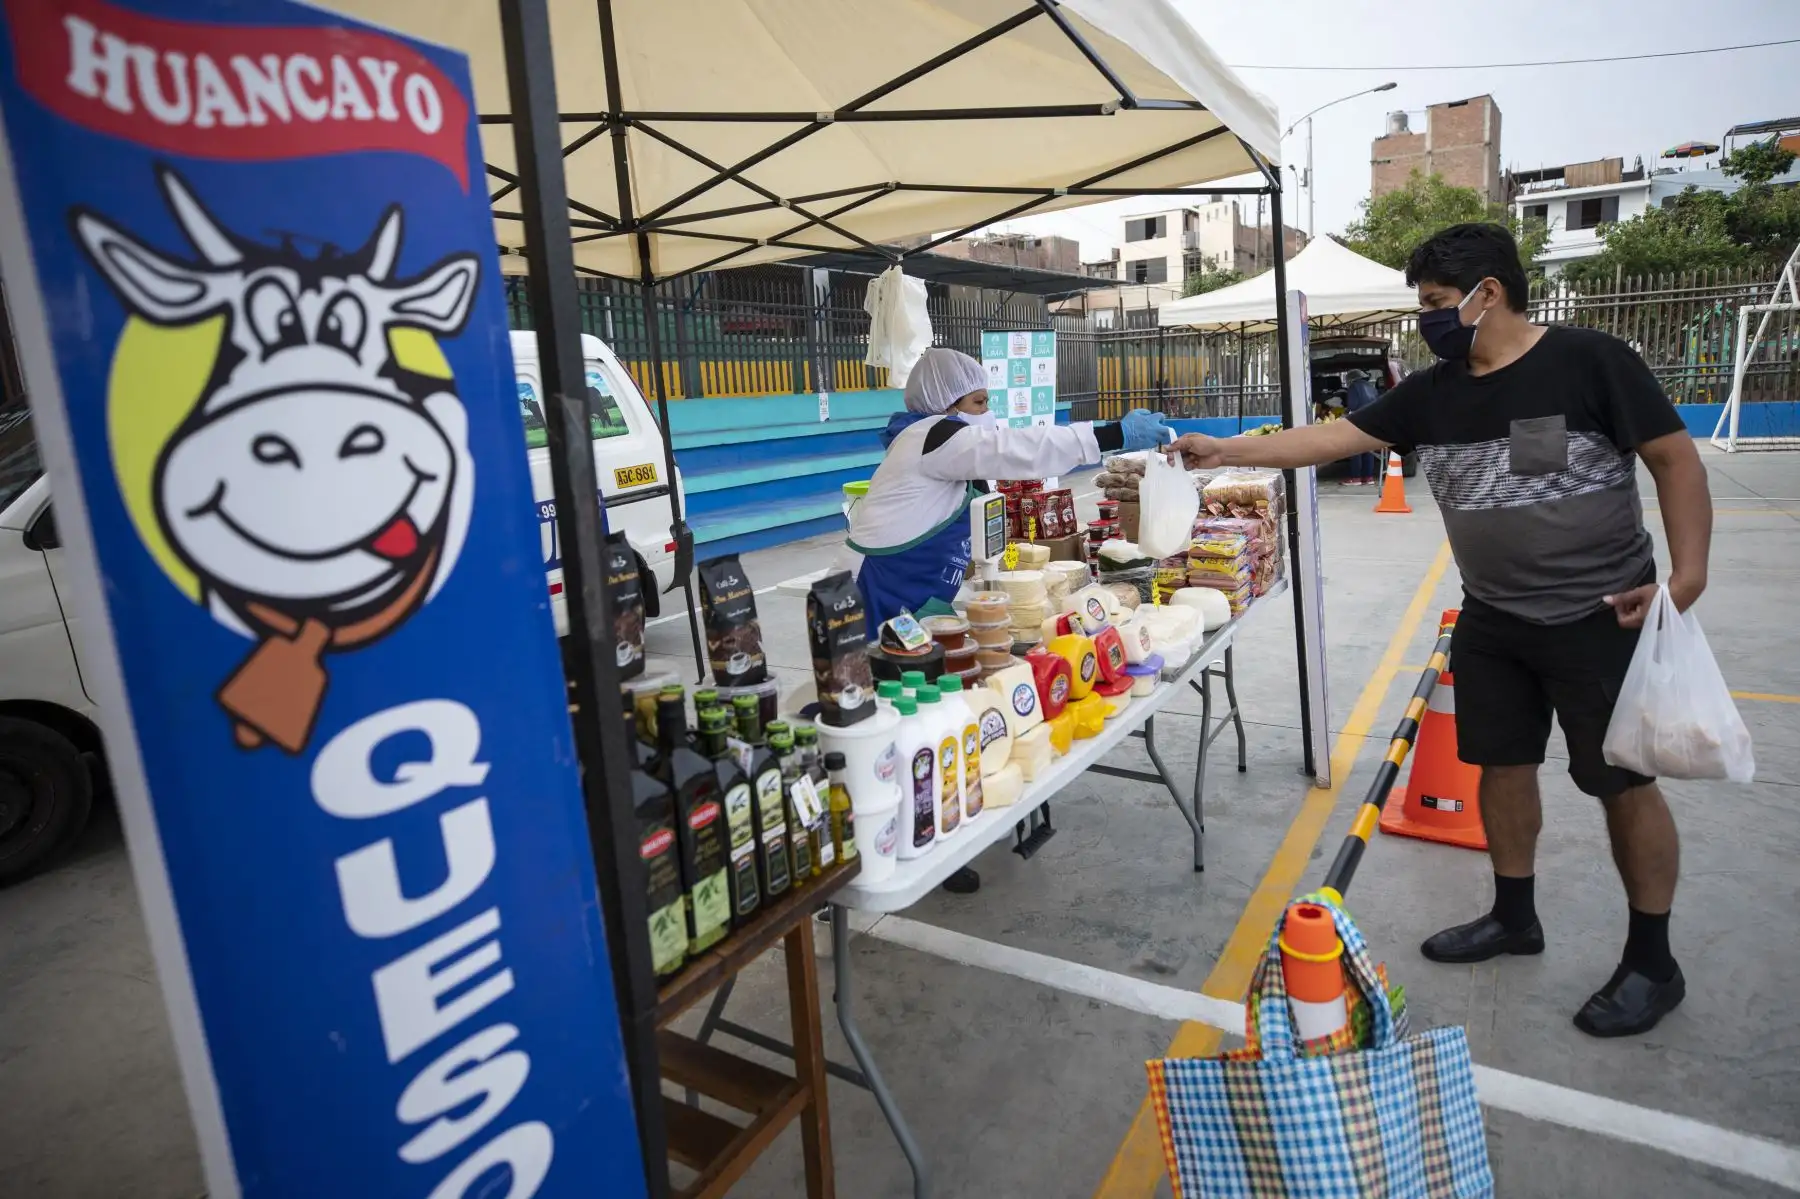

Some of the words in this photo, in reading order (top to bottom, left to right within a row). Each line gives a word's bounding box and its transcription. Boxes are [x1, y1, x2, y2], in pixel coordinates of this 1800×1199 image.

[63, 14, 442, 135] HUANCAYO
[1034, 346, 1050, 355] LIMA
[310, 698, 554, 1199] QUESO
